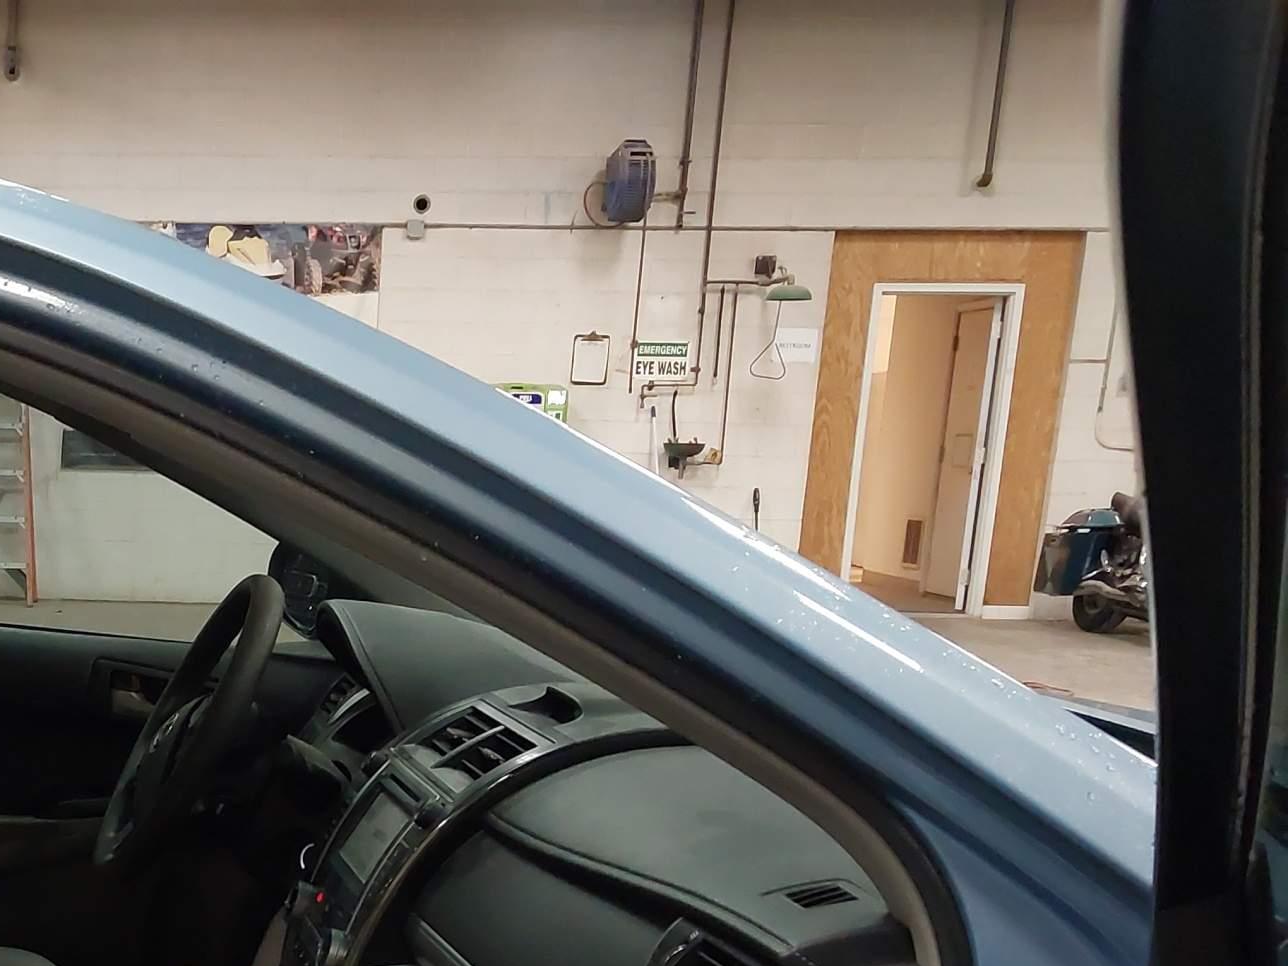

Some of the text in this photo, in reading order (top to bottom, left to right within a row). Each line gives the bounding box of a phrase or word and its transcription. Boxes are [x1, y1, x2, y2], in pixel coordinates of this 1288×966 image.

[638, 345, 688, 355] EMERGENCY
[635, 361, 687, 375] EYE WASH
